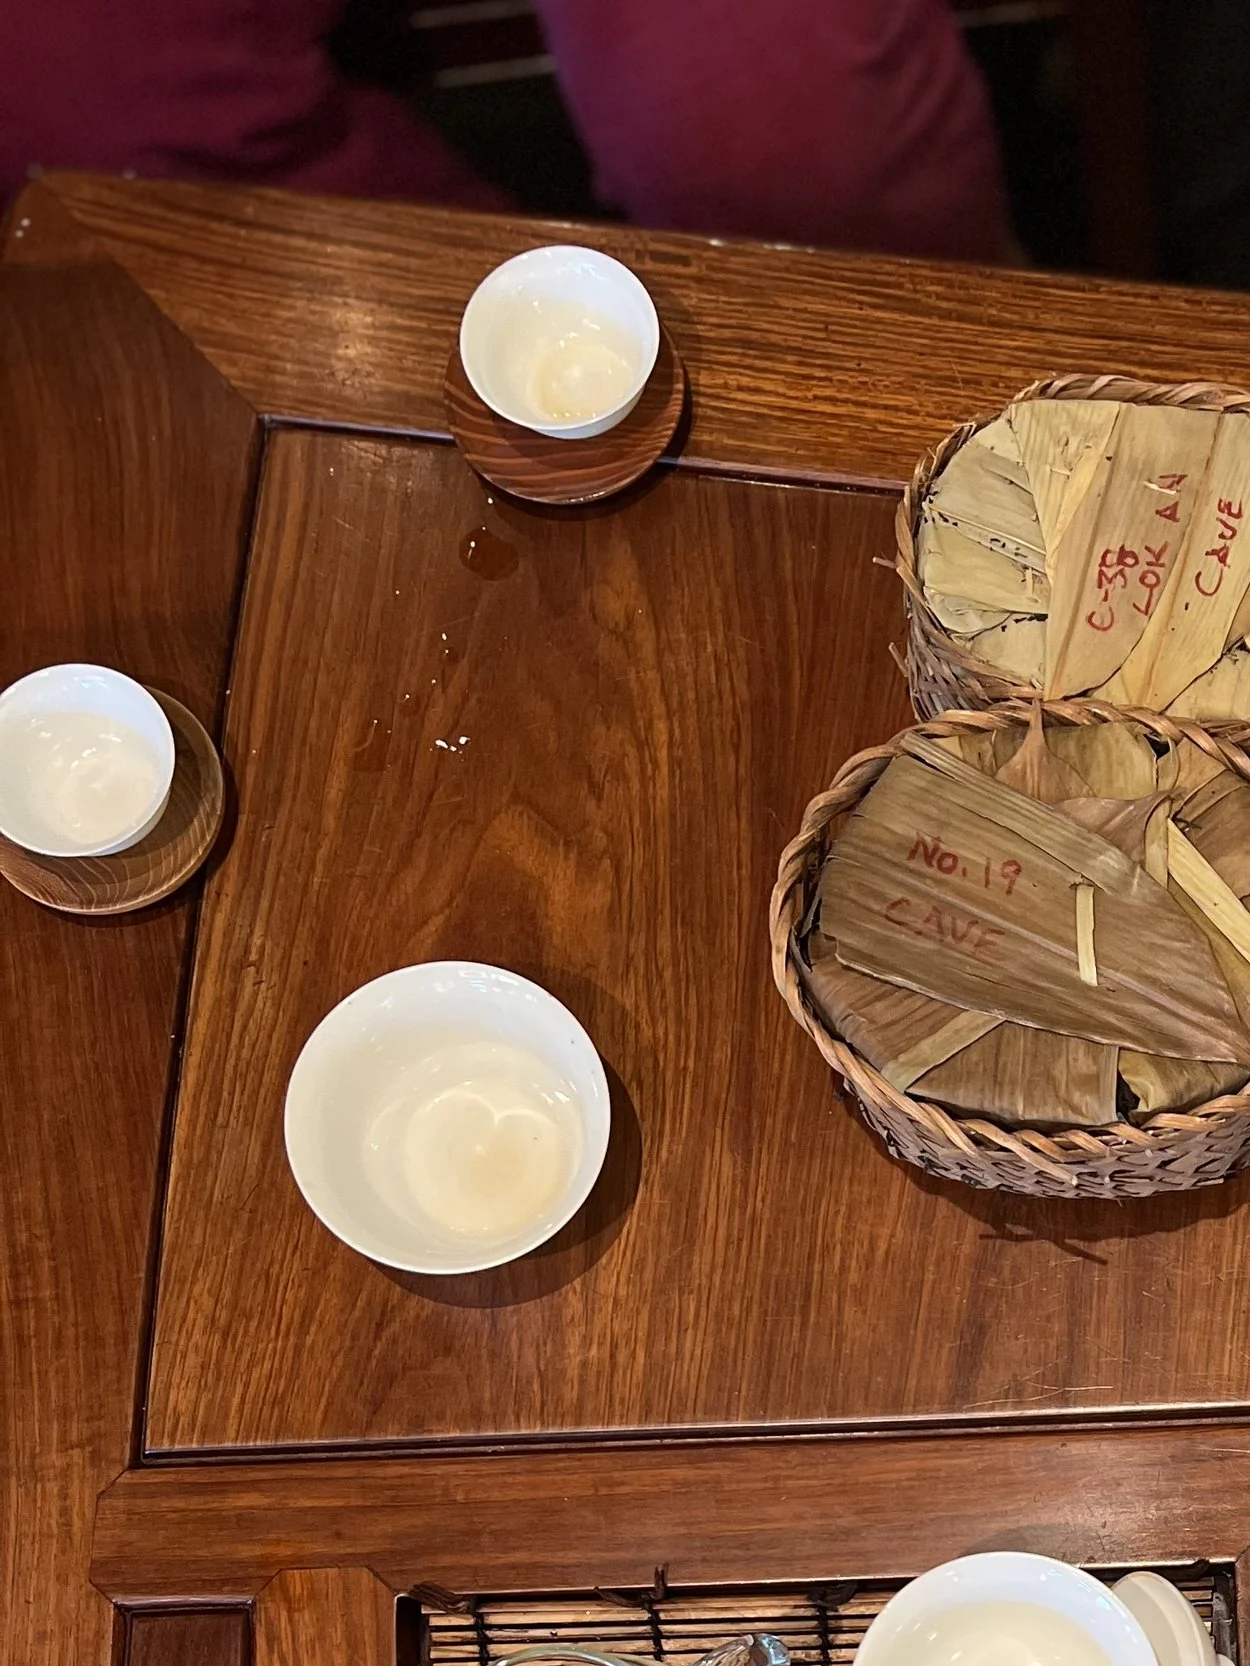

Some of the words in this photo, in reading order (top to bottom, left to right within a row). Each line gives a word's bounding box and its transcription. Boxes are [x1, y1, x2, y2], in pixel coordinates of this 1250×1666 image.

[1133, 541, 1169, 616] LOK
[1195, 498, 1243, 597] CAVE
[884, 896, 1006, 967] CAVE
